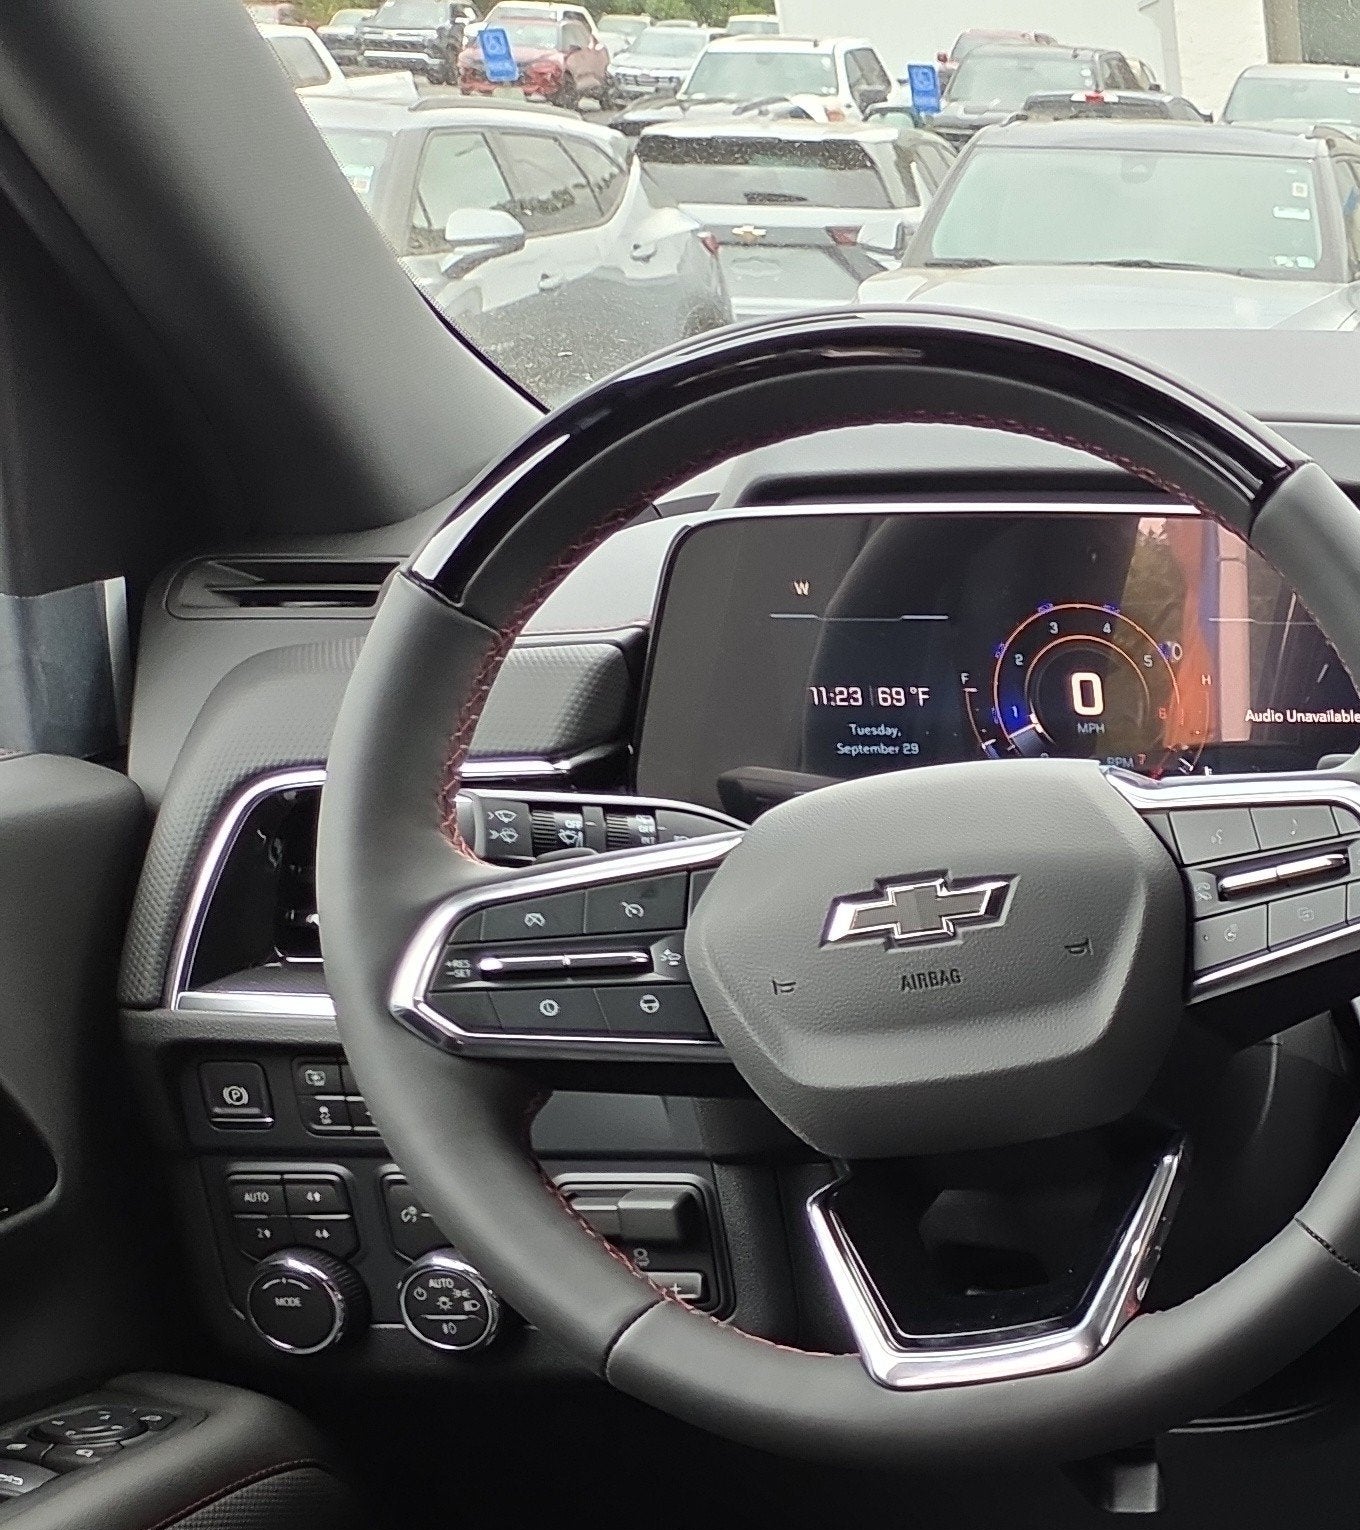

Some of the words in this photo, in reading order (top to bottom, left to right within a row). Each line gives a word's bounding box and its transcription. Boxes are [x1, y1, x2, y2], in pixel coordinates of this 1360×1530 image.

[794, 581, 810, 596] W
[1050, 621, 1060, 635] 3
[1102, 622, 1112, 635] 4
[1014, 653, 1024, 666] 2
[1143, 654, 1154, 668] 5
[960, 672, 970, 685] F
[1201, 674, 1212, 686] H
[810, 686, 863, 706] 11:23
[1071, 671, 1105, 717] 0
[1245, 708, 1284, 723] Audio
[1077, 722, 1106, 735] MPH
[836, 742, 900, 757] September
[900, 968, 962, 992] AIRBAG
[244, 1190, 270, 1203] AUTO
[428, 1277, 455, 1289] AUTO
